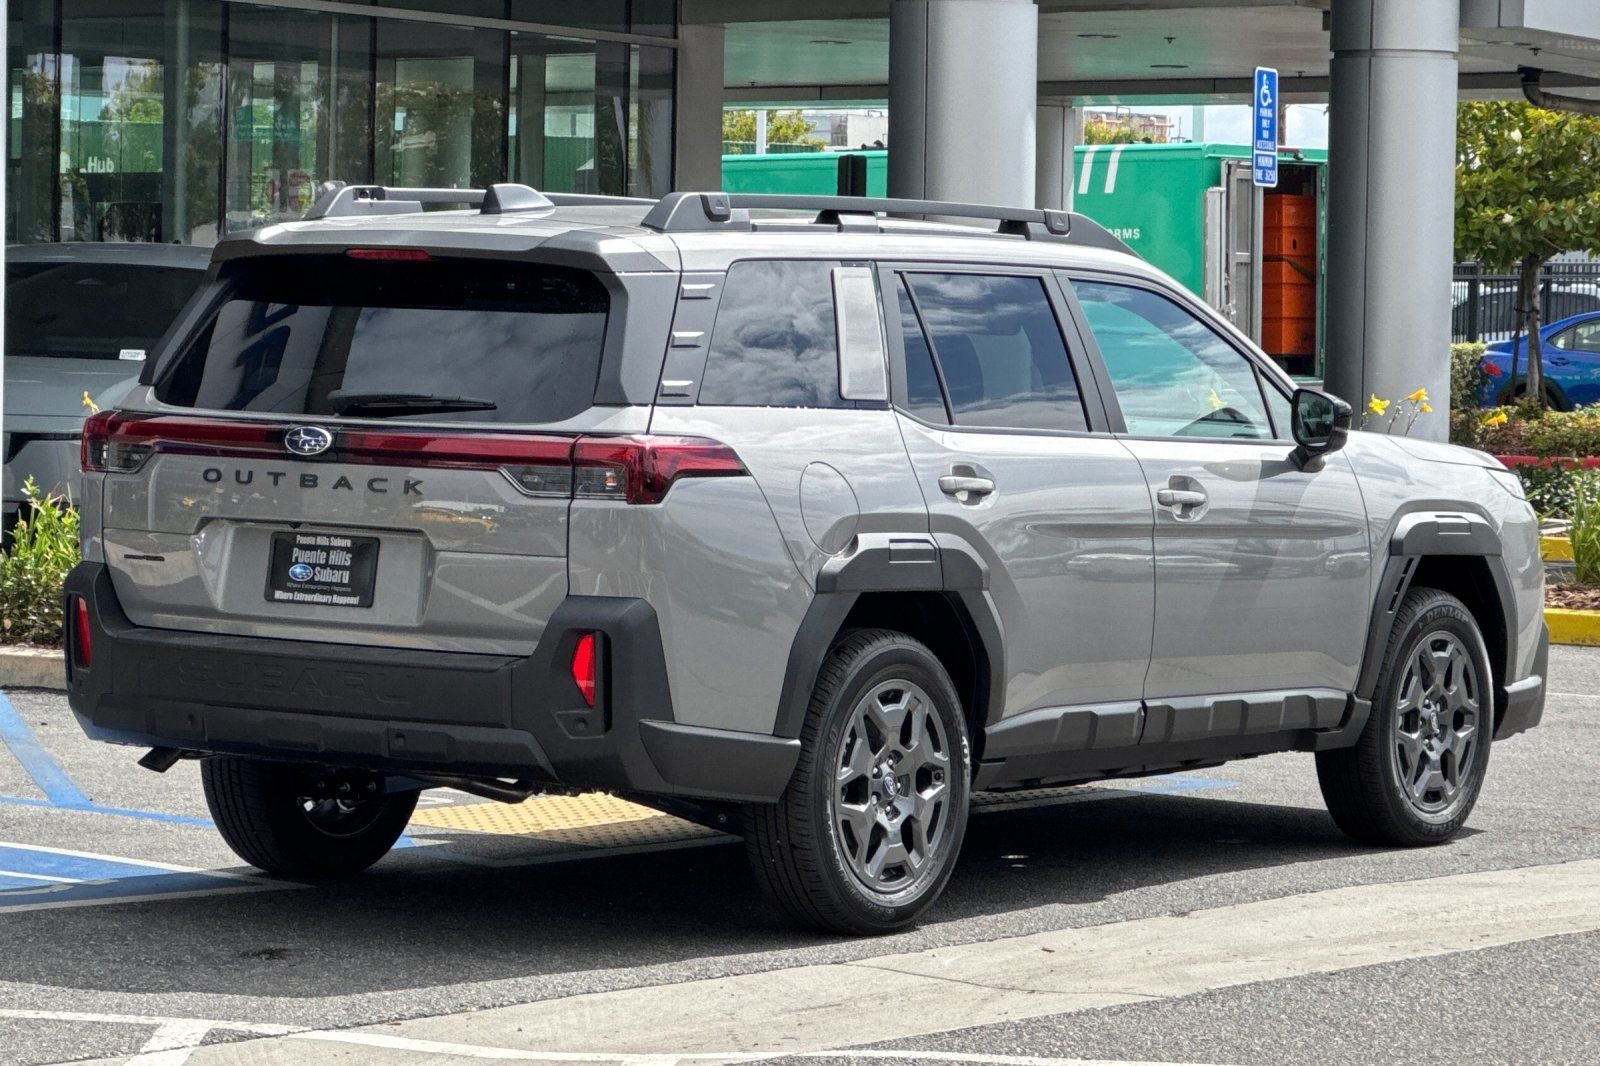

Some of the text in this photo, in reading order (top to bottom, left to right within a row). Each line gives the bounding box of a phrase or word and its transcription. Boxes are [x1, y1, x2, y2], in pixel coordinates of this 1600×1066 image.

[87, 156, 115, 173] Hub
[202, 468, 424, 496] OUTBACK
[296, 535, 352, 548] Puente Hills Subaru
[291, 547, 353, 567] Puente Hills
[314, 566, 350, 584] Subaru
[274, 590, 294, 600] Where
[1426, 606, 1469, 623] DUNLOP
[177, 657, 416, 705] SUBARU
